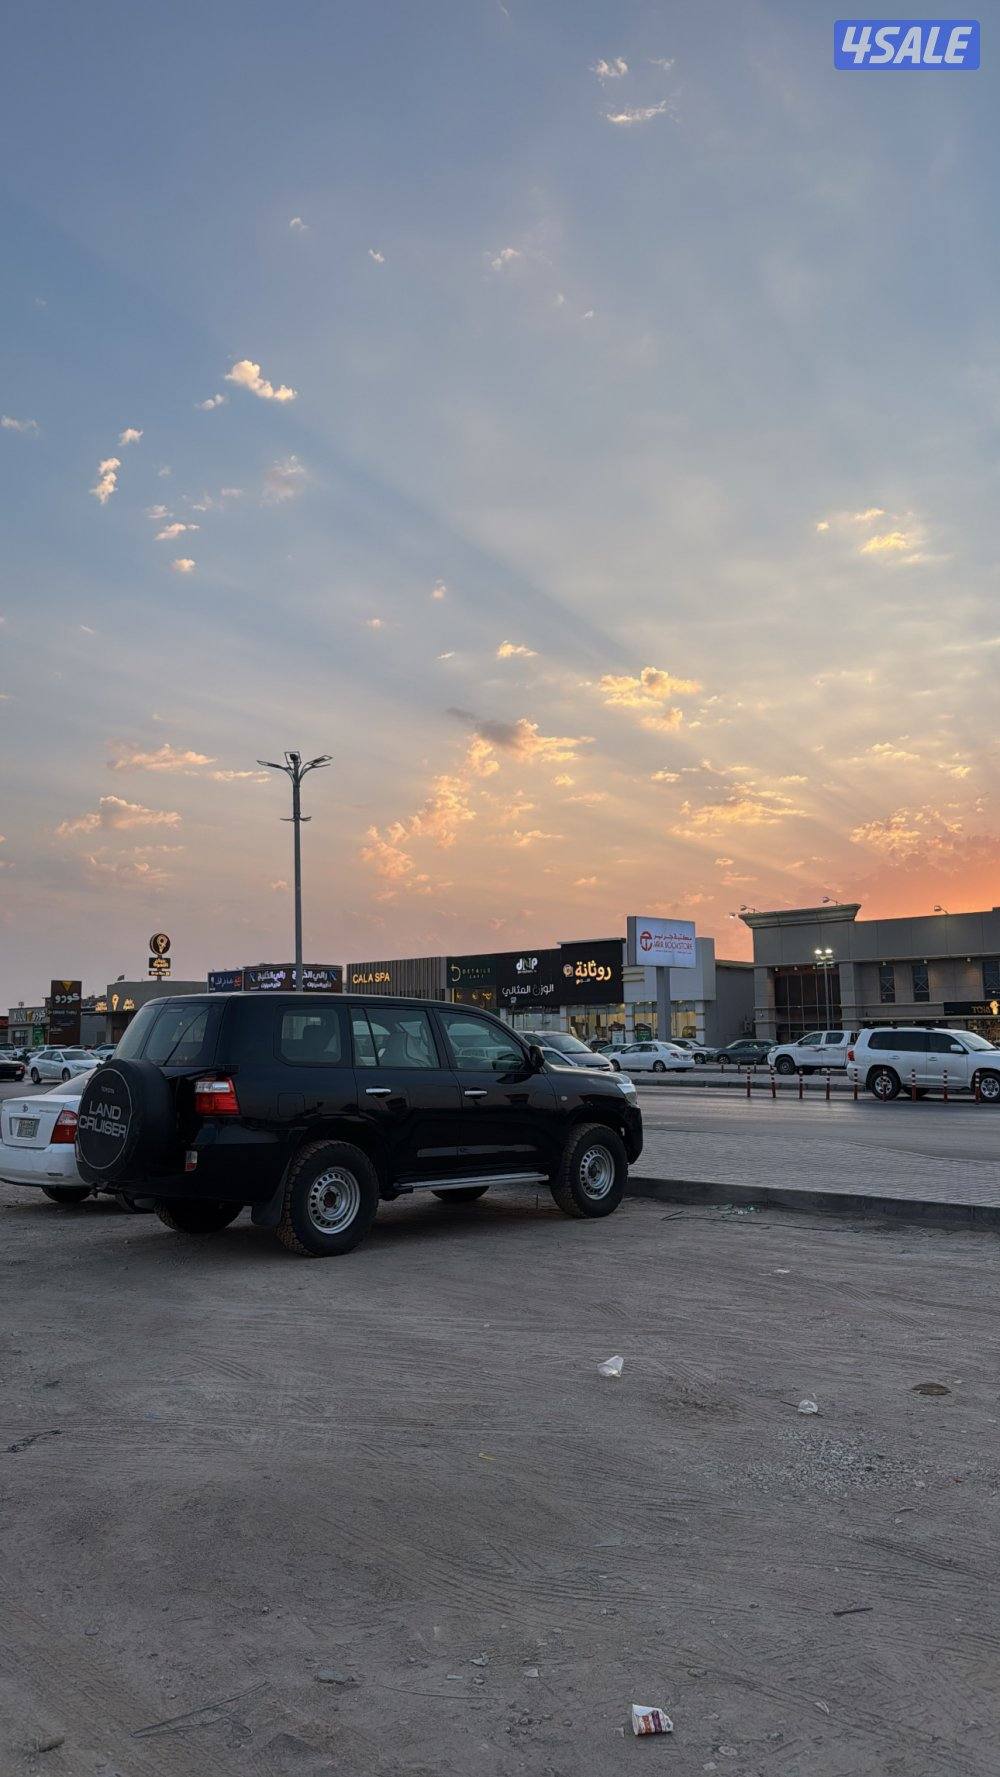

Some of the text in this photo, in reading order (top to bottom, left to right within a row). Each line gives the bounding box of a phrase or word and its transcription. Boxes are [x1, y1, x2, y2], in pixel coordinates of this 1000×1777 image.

[374, 972, 390, 983] SPA
[55, 993, 80, 1004] كودو
[89, 1101, 121, 1120] LAND
[78, 1115, 127, 1138] CRUISER
